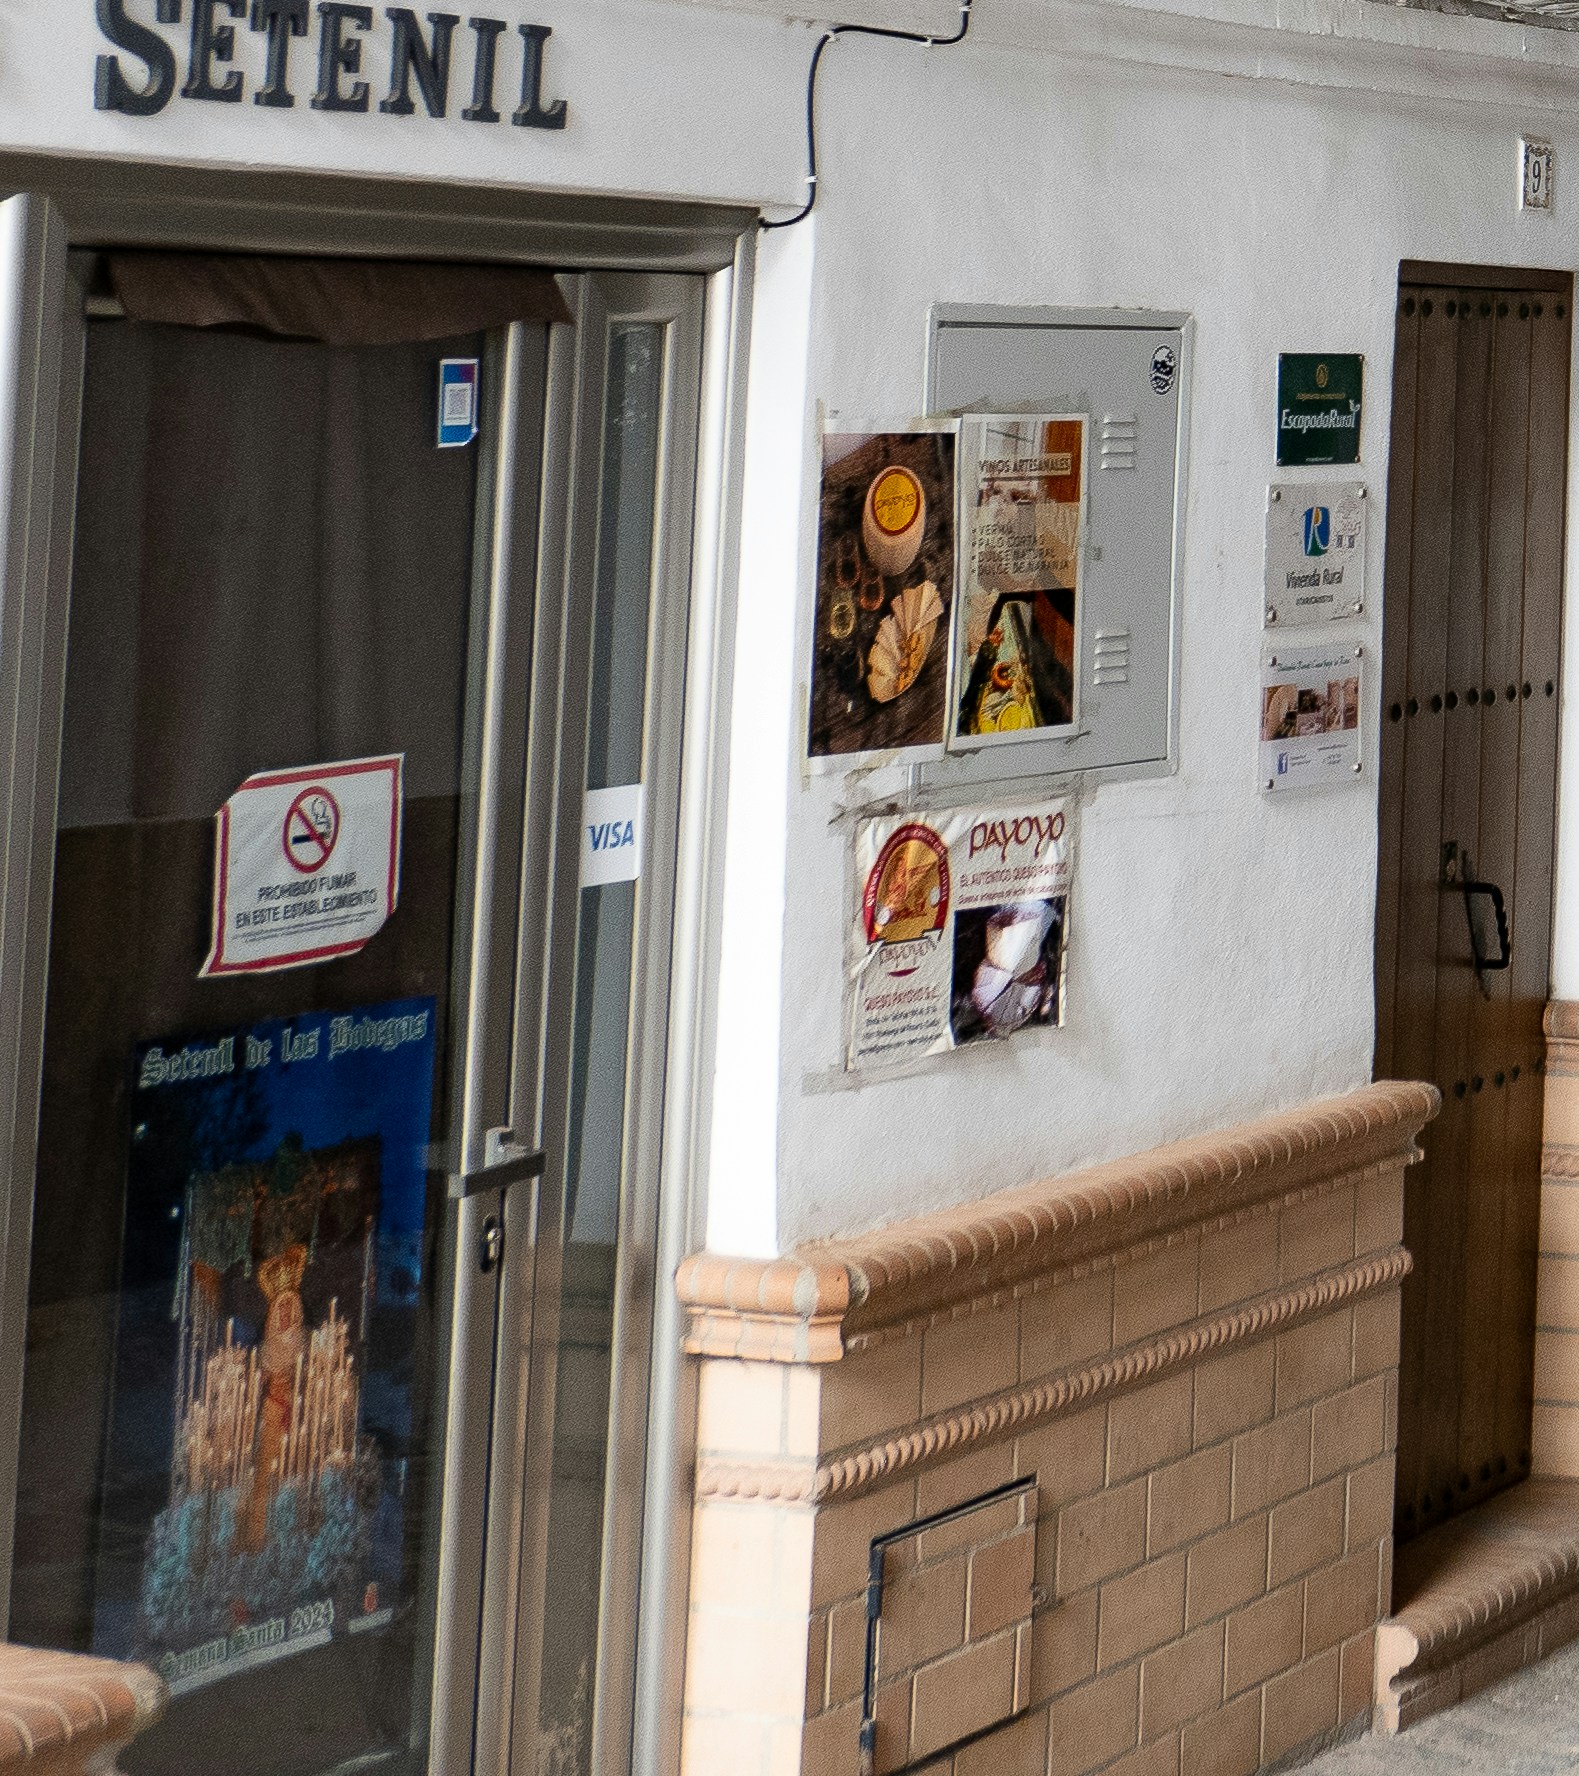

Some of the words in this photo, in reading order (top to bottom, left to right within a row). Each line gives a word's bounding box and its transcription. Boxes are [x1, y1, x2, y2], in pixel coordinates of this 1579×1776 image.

[1532, 160, 1542, 194] 9
[979, 457, 1010, 474] VINOS
[1012, 456, 1070, 473] ARTESANALES
[1322, 565, 1346, 586] Rural
[587, 819, 635, 852] VISA
[968, 811, 1066, 864] PAYOYO
[257, 880, 317, 901] PROHIBIDO
[318, 871, 357, 891] FUMAR
[235, 910, 251, 928] EN
[252, 905, 281, 926] ESTE
[282, 888, 378, 920] ESTABLECIMIENTO
[138, 1036, 236, 1090] Setenil
[245, 1035, 272, 1070] de
[281, 1027, 321, 1063] las
[229, 1616, 286, 1658] Santa
